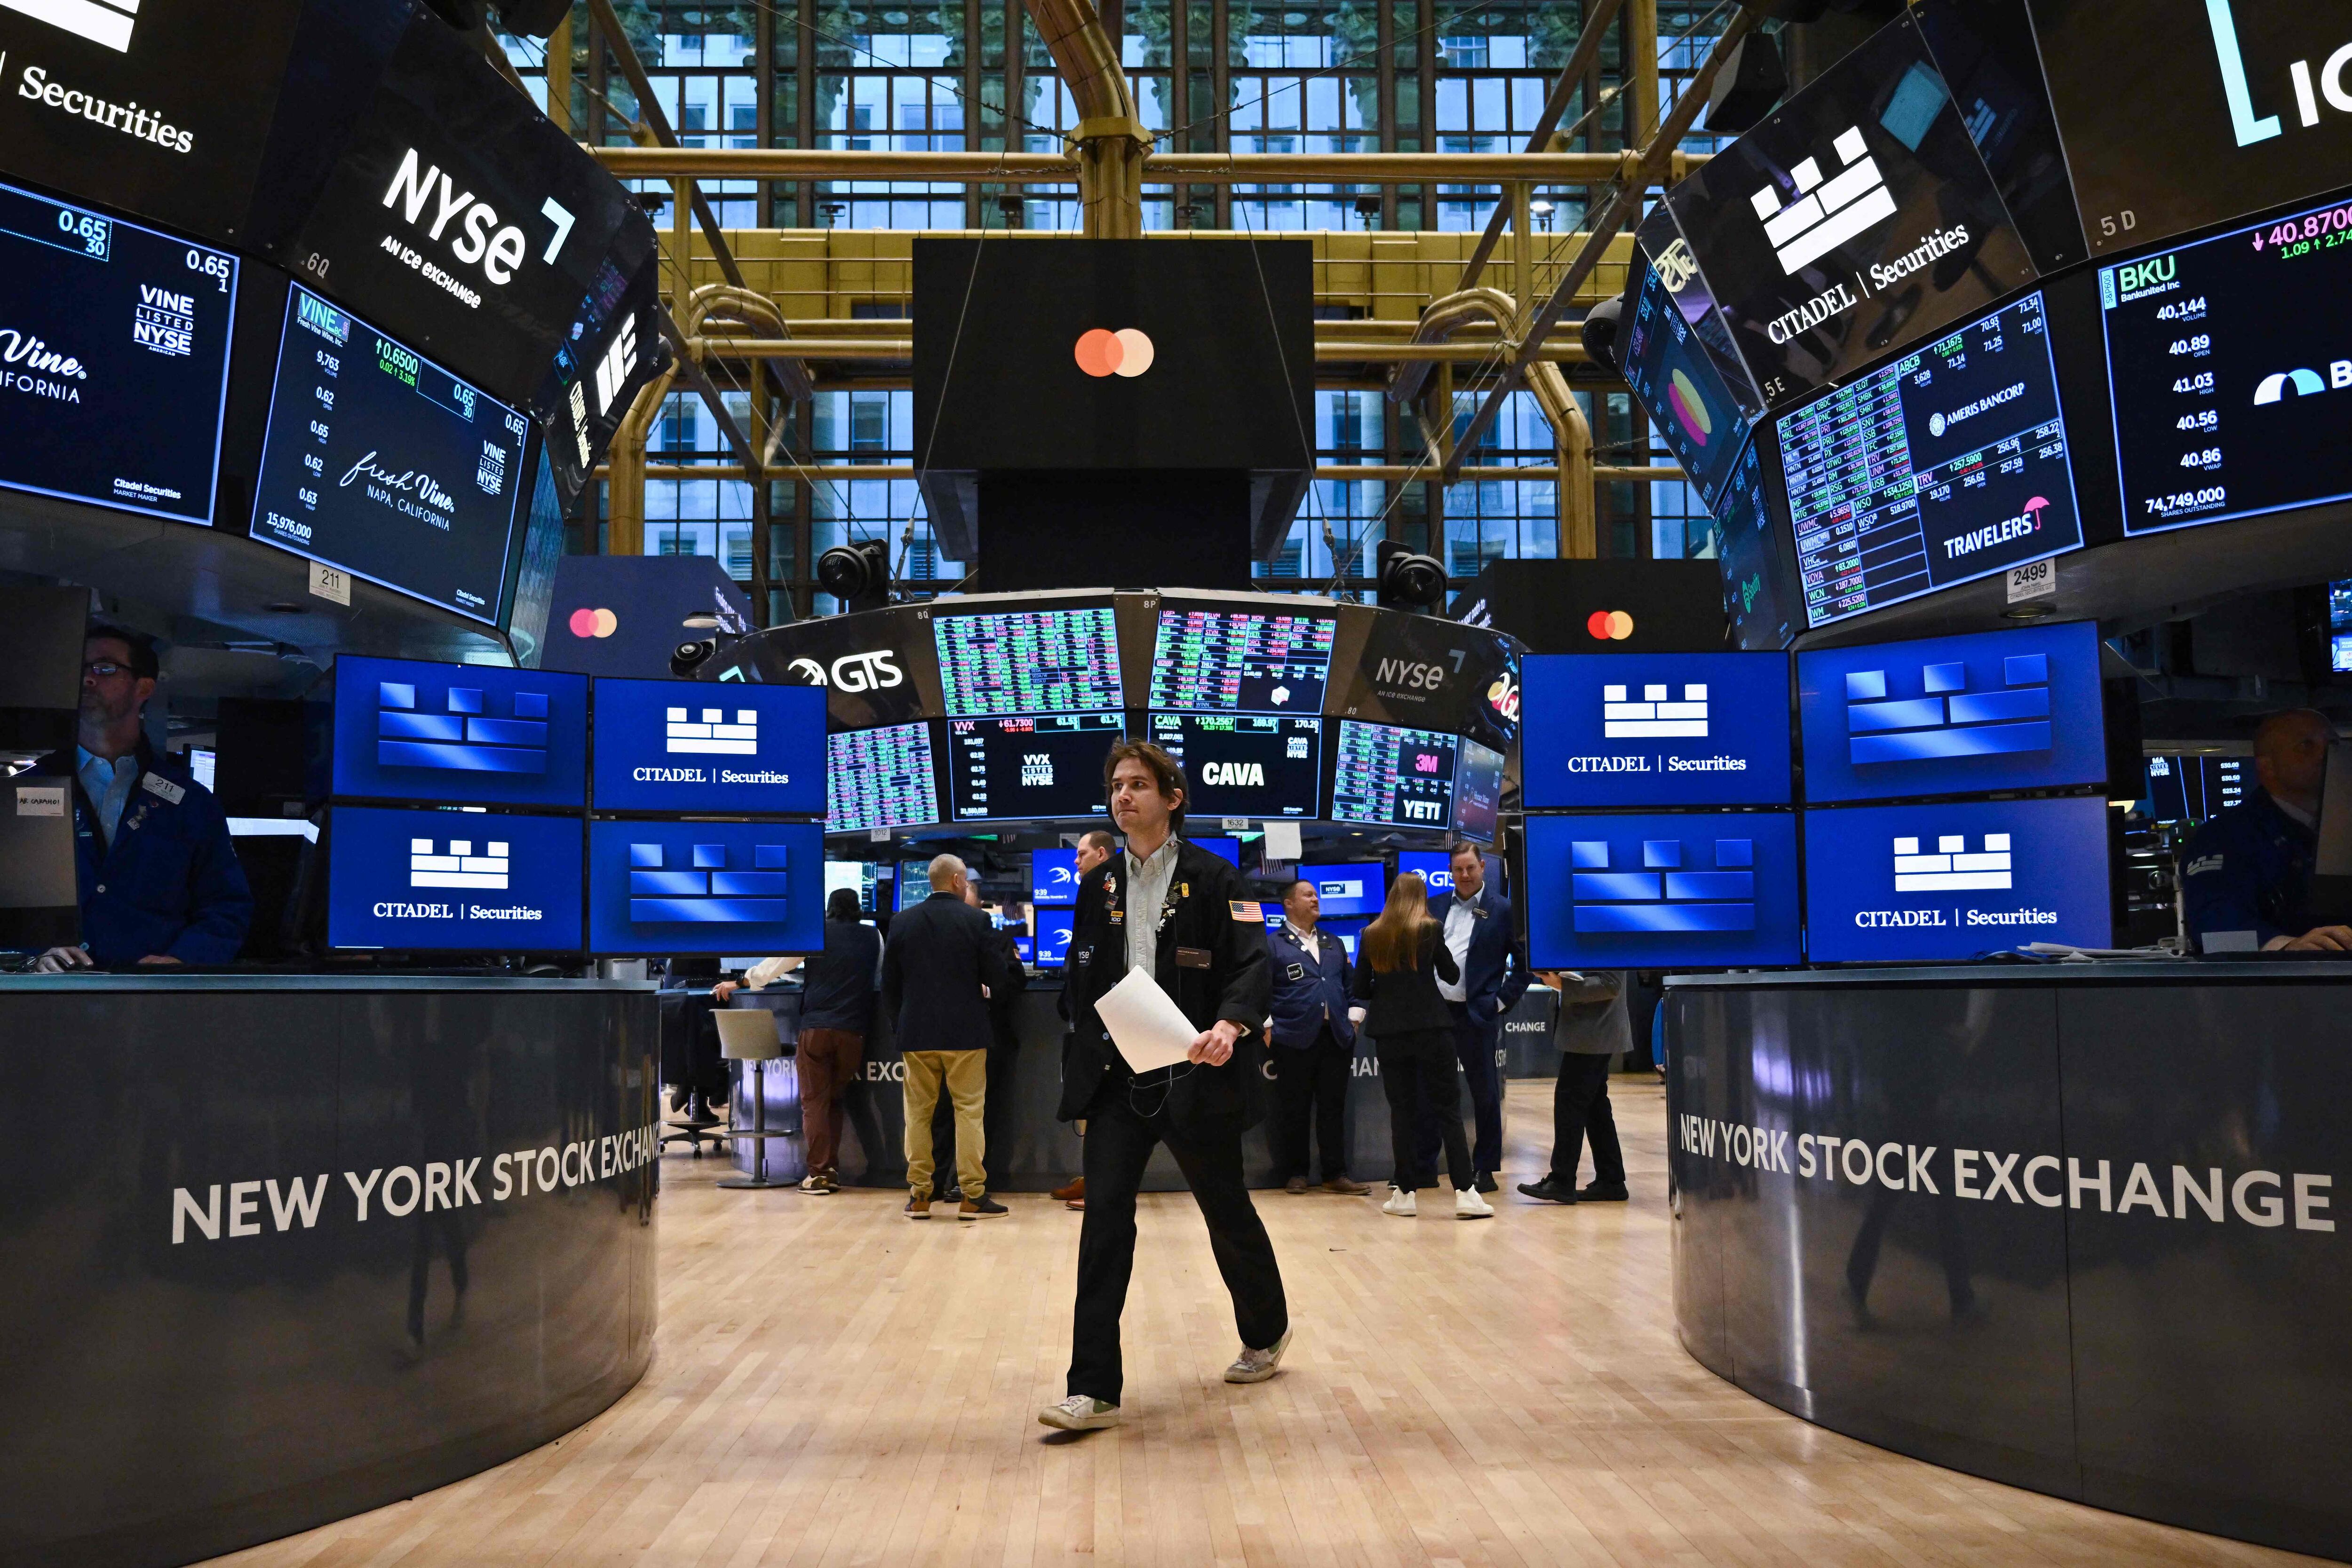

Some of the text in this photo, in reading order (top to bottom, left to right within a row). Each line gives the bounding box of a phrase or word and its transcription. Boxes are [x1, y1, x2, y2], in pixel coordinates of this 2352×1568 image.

[18, 66, 193, 153] Securities
[59, 210, 106, 241] 0.65
[85, 238, 105, 256] 30
[381, 236, 400, 255] AN
[2281, 241, 2310, 259] 1.09
[186, 249, 230, 278] 0.65
[2120, 255, 2175, 292] BKU
[218, 278, 227, 293] 1
[1767, 224, 1970, 345] CITADEL Securities
[2104, 275, 2113, 304] S&P600
[2121, 281, 2180, 302] Bankunited Inc
[141, 284, 194, 316] VINE
[2018, 297, 2038, 314] 71.34
[2156, 296, 2206, 320] 40,144
[136, 307, 193, 331] LISTED
[301, 292, 338, 333] VINE
[2182, 312, 2206, 322] VOLUME
[297, 318, 334, 343] Fresh Vine Wine,
[2022, 317, 2042, 334] 71.00
[134, 321, 192, 353] NYSE
[1937, 334, 1963, 354] 71.1675
[1984, 335, 2002, 352] 71.25
[2169, 335, 2210, 355] 40.89
[317, 350, 340, 371] 9,763
[383, 342, 418, 374] 0.6500
[1947, 353, 1965, 369] 71.14
[2193, 349, 2210, 358] OPEN
[380, 359, 415, 386] 0.02 3.19%
[1899, 355, 1921, 374] ABCB
[1914, 370, 1931, 385] 3,628
[2172, 372, 2214, 393] 41.03
[316, 386, 334, 405] 0.62
[454, 384, 475, 407] 0.65
[2199, 387, 2214, 396] HIGH
[463, 405, 472, 418] 30
[1817, 399, 1831, 411] OBDC
[1947, 382, 2025, 424] AMERIS BANCORP
[311, 420, 328, 438] 0.65
[506, 414, 524, 436] 0.65
[1780, 418, 1791, 430] MET
[2177, 410, 2217, 430] 40.56
[2035, 422, 2059, 439] 258.22
[517, 436, 521, 446] 1
[484, 440, 506, 464] VINE
[2039, 443, 2063, 459] 256.38
[2180, 448, 2222, 468] 40.86
[305, 454, 323, 471] 0.62
[479, 458, 504, 475] LISTED
[1954, 452, 1982, 470] 257.5900
[2000, 458, 2023, 474] 257.59
[2203, 463, 2222, 471] VWAP
[477, 469, 502, 492] NYSE
[1872, 477, 1885, 489] USB
[1917, 472, 1933, 486] TRV
[1963, 472, 1985, 487] 256.62
[114, 478, 181, 499] Citadel Securities
[114, 489, 158, 502] MARKET MAKER
[299, 488, 317, 505] 0.63
[1930, 485, 1950, 500] 19,170
[367, 484, 449, 531] NAPA, CALIFORNIA
[1855, 497, 1871, 511] WSO
[1890, 499, 1915, 515] 518.9700
[2145, 486, 2225, 514] 74,749,000
[2161, 501, 2225, 518] SHARES OUTSTANDING
[267, 512, 311, 539] 15,976,000
[1797, 518, 1819, 533] UWMC
[1944, 513, 2033, 559] TRAVELERS
[1839, 540, 1856, 553] 6.0800
[322, 570, 339, 588] 211
[1806, 570, 1824, 584] VOYA
[2013, 563, 2047, 586] 2499
[1809, 589, 1825, 601] WCN
[1812, 607, 1824, 618] WM
[831, 650, 903, 692] GTS
[954, 721, 975, 731] VVX
[1004, 719, 1033, 727] 61.7300
[1155, 715, 1182, 726] CAVA
[1023, 754, 1049, 765] VVX
[1415, 754, 1438, 773] 3M
[1568, 756, 1747, 772] CITADEL Securities
[633, 768, 789, 785] CITADEL Securities
[1022, 776, 1053, 786] NYSE
[1202, 762, 1264, 786] CAVA
[156, 779, 175, 792] 211
[1403, 800, 1441, 820] YETI
[373, 903, 541, 921] CITADEL Securities
[1855, 908, 2058, 928] CITADEL Securities
[1505, 1022, 1546, 1032] CHANGE
[1680, 1113, 2336, 1232] NEW YORK STOCK EXCHANGE
[172, 1174, 329, 1244] NEW
[345, 1157, 482, 1221] YORK
[493, 1139, 596, 1200] STOCK
